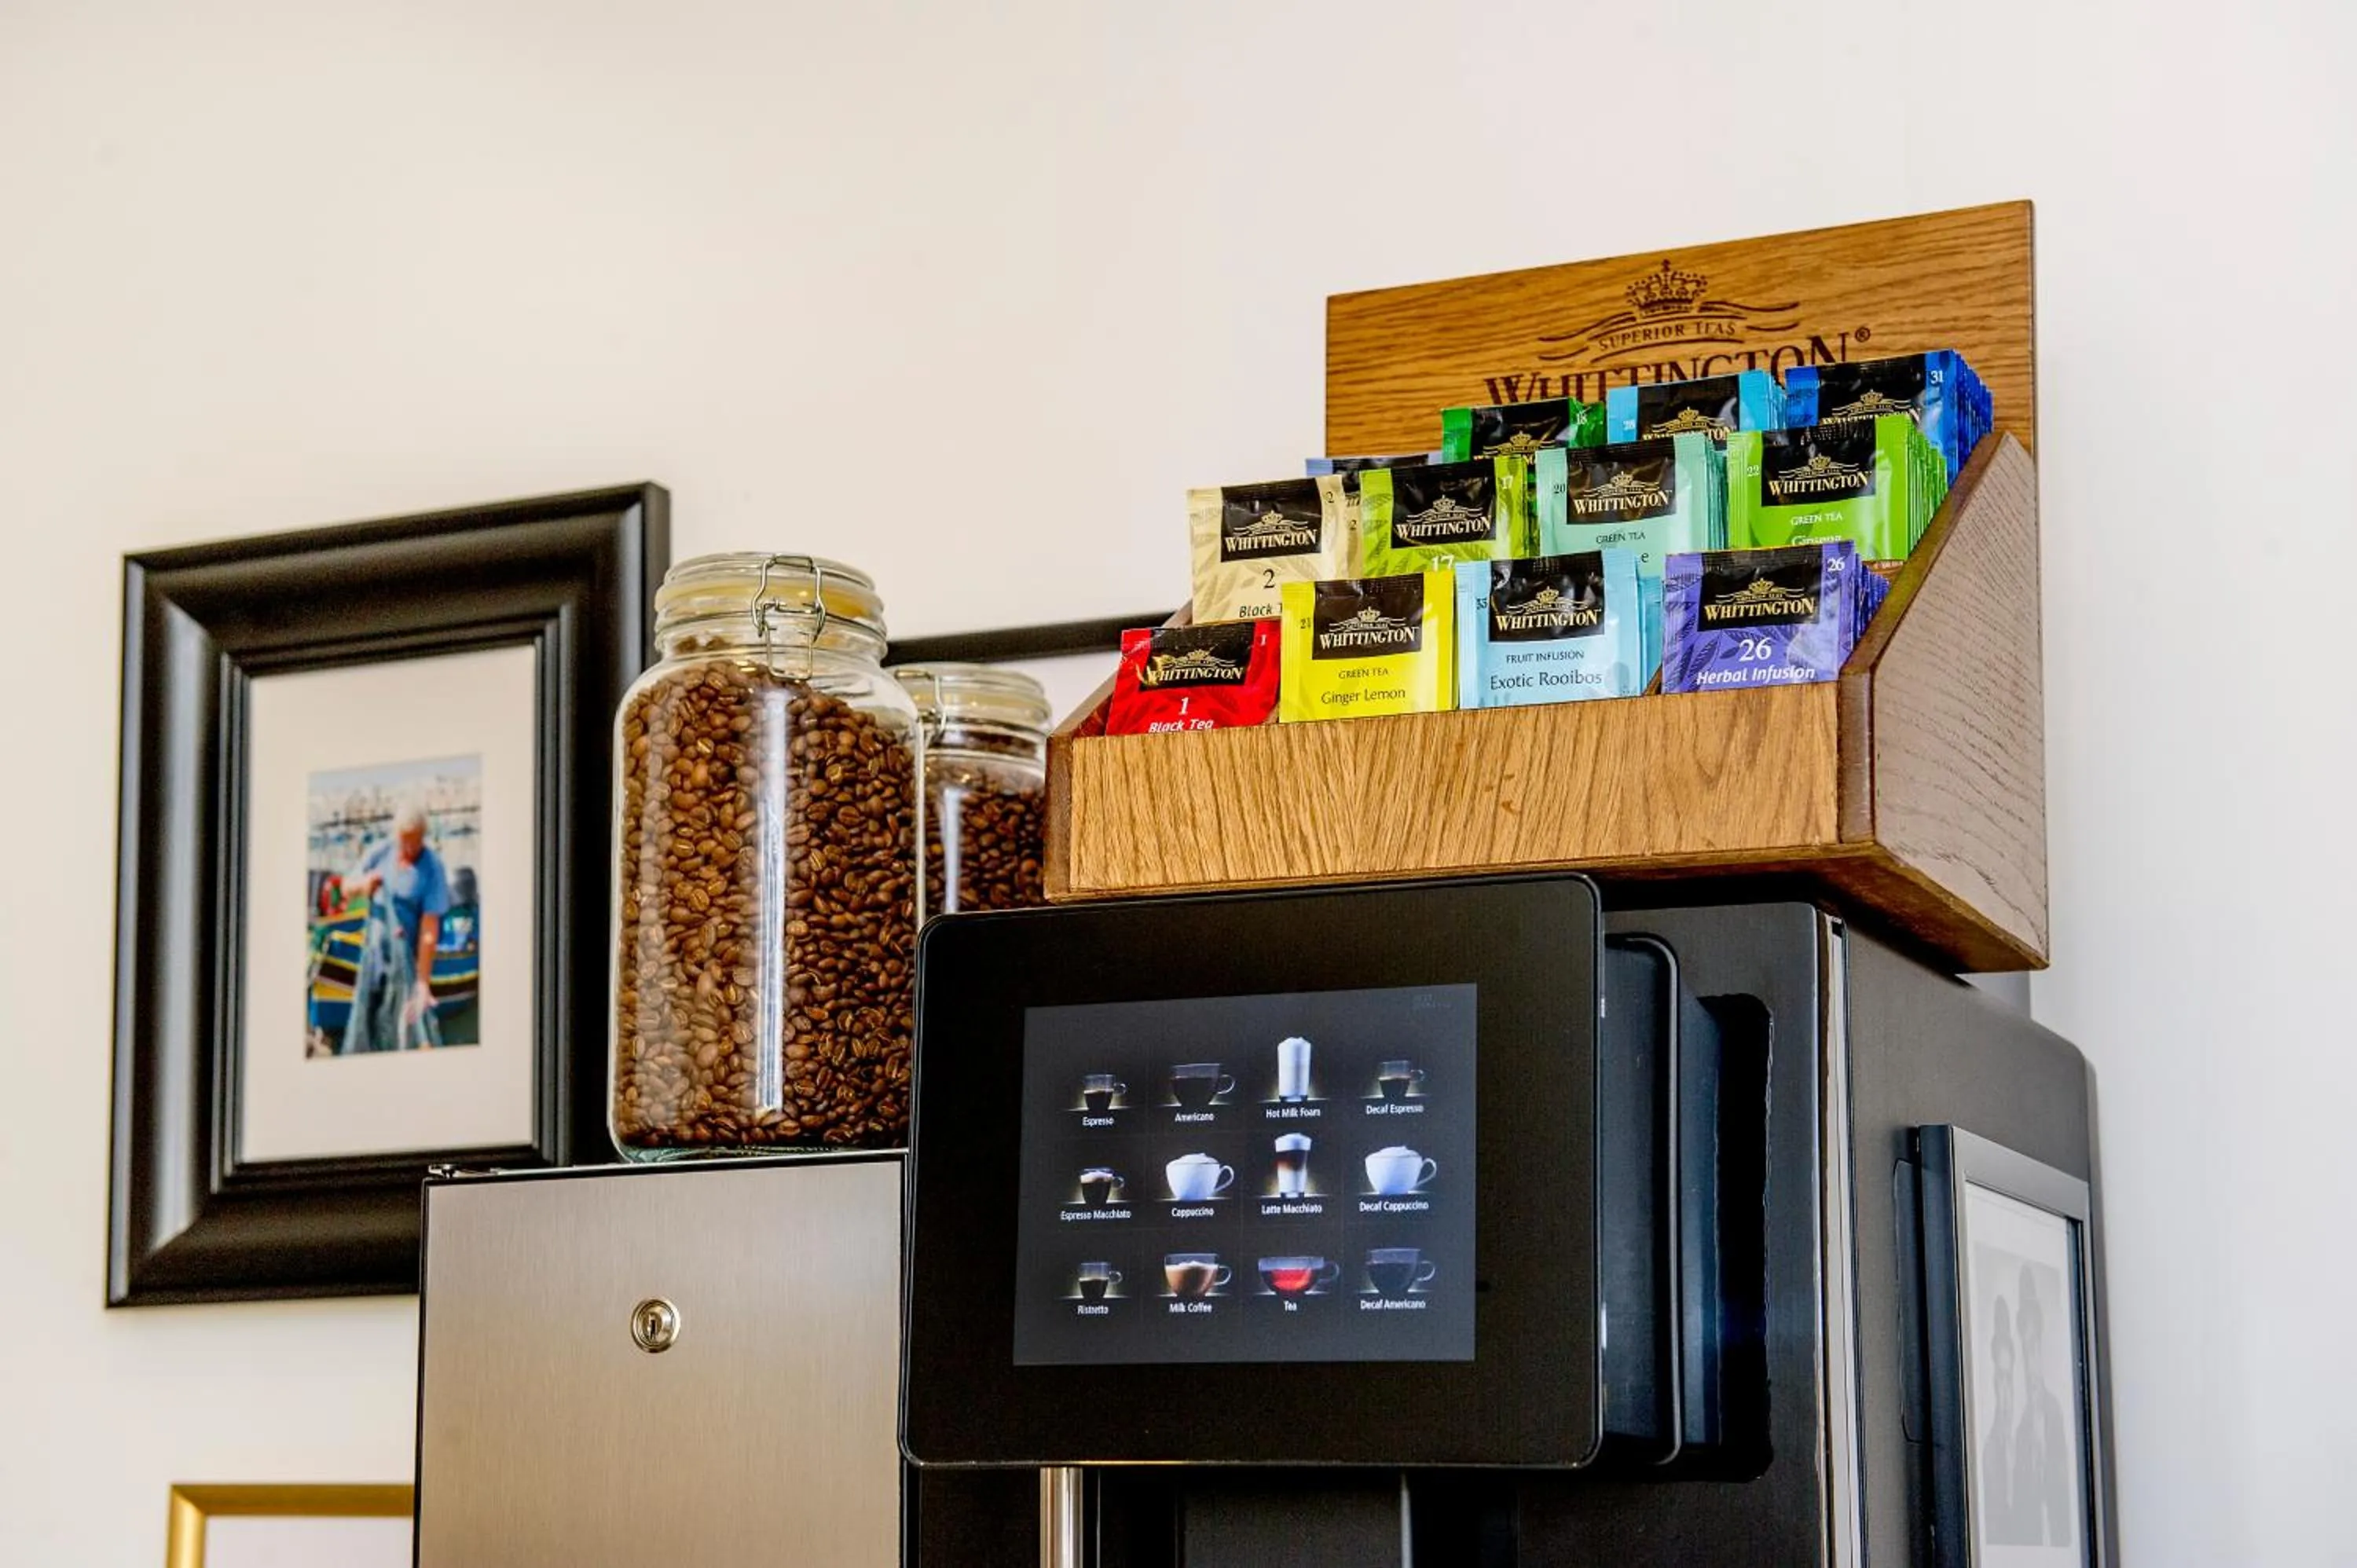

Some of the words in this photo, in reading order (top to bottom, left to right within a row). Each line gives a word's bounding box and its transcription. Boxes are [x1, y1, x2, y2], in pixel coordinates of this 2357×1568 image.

[1598, 324, 1684, 351] SUPERIOR
[1694, 321, 1736, 335] TEAS
[1930, 370, 1944, 384] 31
[1747, 465, 1760, 477] 22
[1553, 483, 1566, 494] 20
[1769, 471, 1868, 496] WHITTINGTON
[1325, 491, 1334, 504] 2
[1573, 490, 1670, 515] WHITTINGTON
[1791, 515, 1822, 526] GREEN
[1825, 512, 1843, 522] TEA
[1396, 515, 1491, 538] WHITTINGTON
[1225, 529, 1317, 552] WHITTINGTON
[1596, 533, 1626, 544] GREEN
[1629, 532, 1645, 540] TEA
[1827, 557, 1845, 572] 26
[1263, 569, 1275, 588] 2
[1239, 603, 1273, 617] Black
[1704, 597, 1816, 621] WHITTINGTON
[1495, 609, 1598, 632] WHITTINGTON
[1260, 635, 1266, 646] 1
[1319, 627, 1416, 650] WHITTINGTON
[1505, 653, 1534, 663] FRUIT
[1536, 650, 1584, 661] INFUSION
[1739, 638, 1772, 661] 26
[1146, 666, 1244, 686] WHITTINGTON
[1338, 669, 1369, 679] GREEN
[1373, 668, 1389, 676] TEA
[1490, 673, 1534, 690] Exotic
[1539, 669, 1602, 686] Rooibos
[1696, 668, 1747, 685] Herbal
[1751, 666, 1815, 683] Infusion
[1321, 691, 1361, 705] Ginger
[1364, 689, 1406, 699] Lemon
[1179, 697, 1189, 716] 1
[1149, 720, 1182, 733] Black
[1189, 719, 1214, 731] Tea
[1266, 1109, 1279, 1118] Hot
[1281, 1108, 1298, 1118] Milk
[1366, 1104, 1388, 1115] Decaf
[1390, 1104, 1424, 1114] Espresso
[1083, 1116, 1114, 1126] Espresso
[1175, 1112, 1215, 1122] Americano
[1171, 1207, 1214, 1218] Cappuccino
[1261, 1204, 1281, 1214] Latte
[1282, 1203, 1322, 1214] Macchiato
[1359, 1201, 1382, 1212] Decaf
[1383, 1200, 1429, 1212] Cappuccino
[1061, 1211, 1092, 1221] Espresso
[1093, 1209, 1131, 1219] Macchiato
[1169, 1303, 1186, 1313] Milk
[1187, 1302, 1212, 1313] Coffee
[1284, 1300, 1297, 1311] Tea
[1360, 1299, 1383, 1310] Decaf
[1384, 1299, 1425, 1310] Americano
